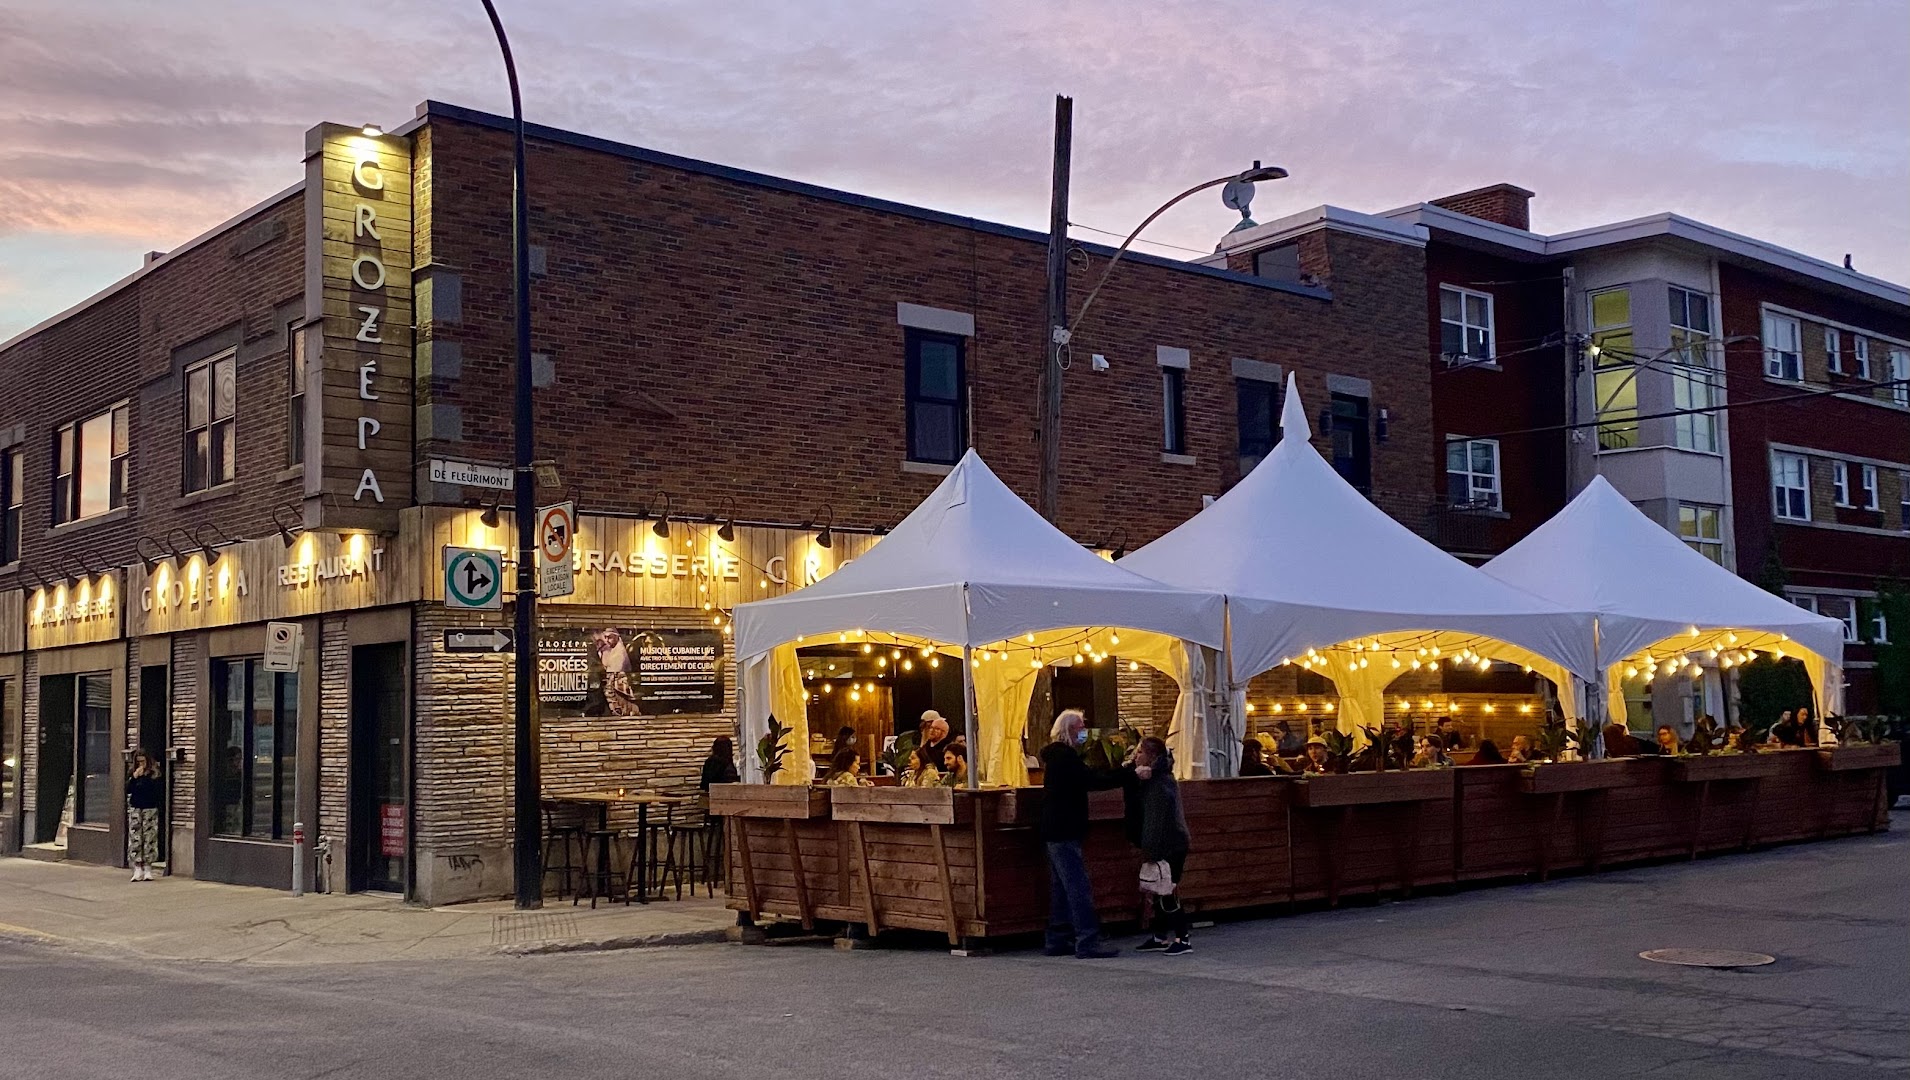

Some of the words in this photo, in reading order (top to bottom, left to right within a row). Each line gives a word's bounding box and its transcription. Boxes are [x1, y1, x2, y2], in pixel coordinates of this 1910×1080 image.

[352, 154, 386, 502] GROZÉPA
[434, 469, 447, 480] DE
[451, 471, 509, 487] FLEURIMONT
[278, 548, 384, 586] RESTAURANT
[547, 581, 566, 591] LOCALE
[640, 647, 671, 655] MUSIQUE
[672, 647, 700, 655] CUBAINE
[701, 646, 715, 654] LIVE
[539, 656, 589, 672] SOIRÉES
[539, 673, 589, 692] CUBAINES
